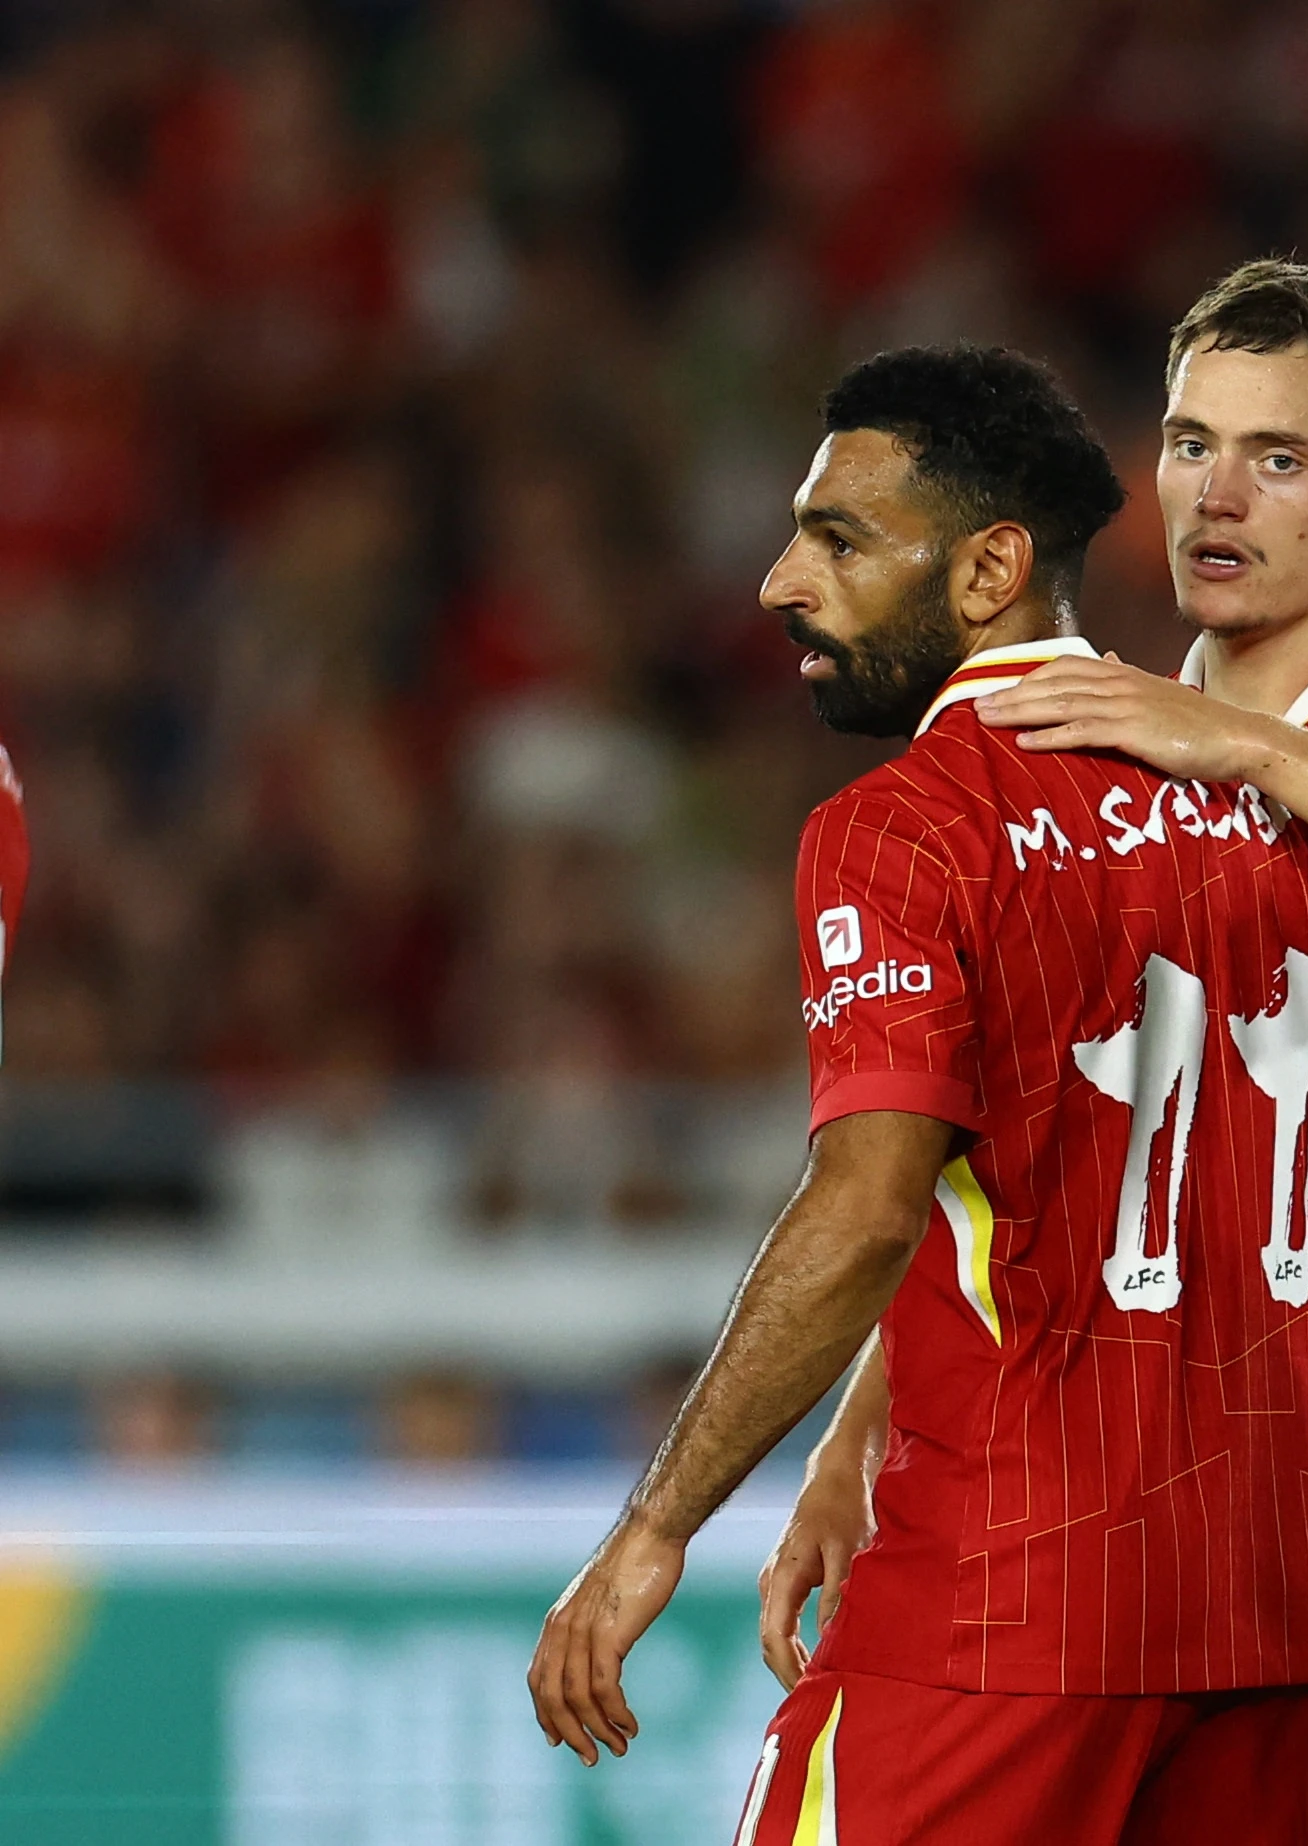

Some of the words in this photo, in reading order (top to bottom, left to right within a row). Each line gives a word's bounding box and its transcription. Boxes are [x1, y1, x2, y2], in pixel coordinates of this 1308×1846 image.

[1005, 807, 1096, 872] M.
[1123, 1268, 1166, 1290] LFC
[1275, 1263, 1303, 1284] LFC
